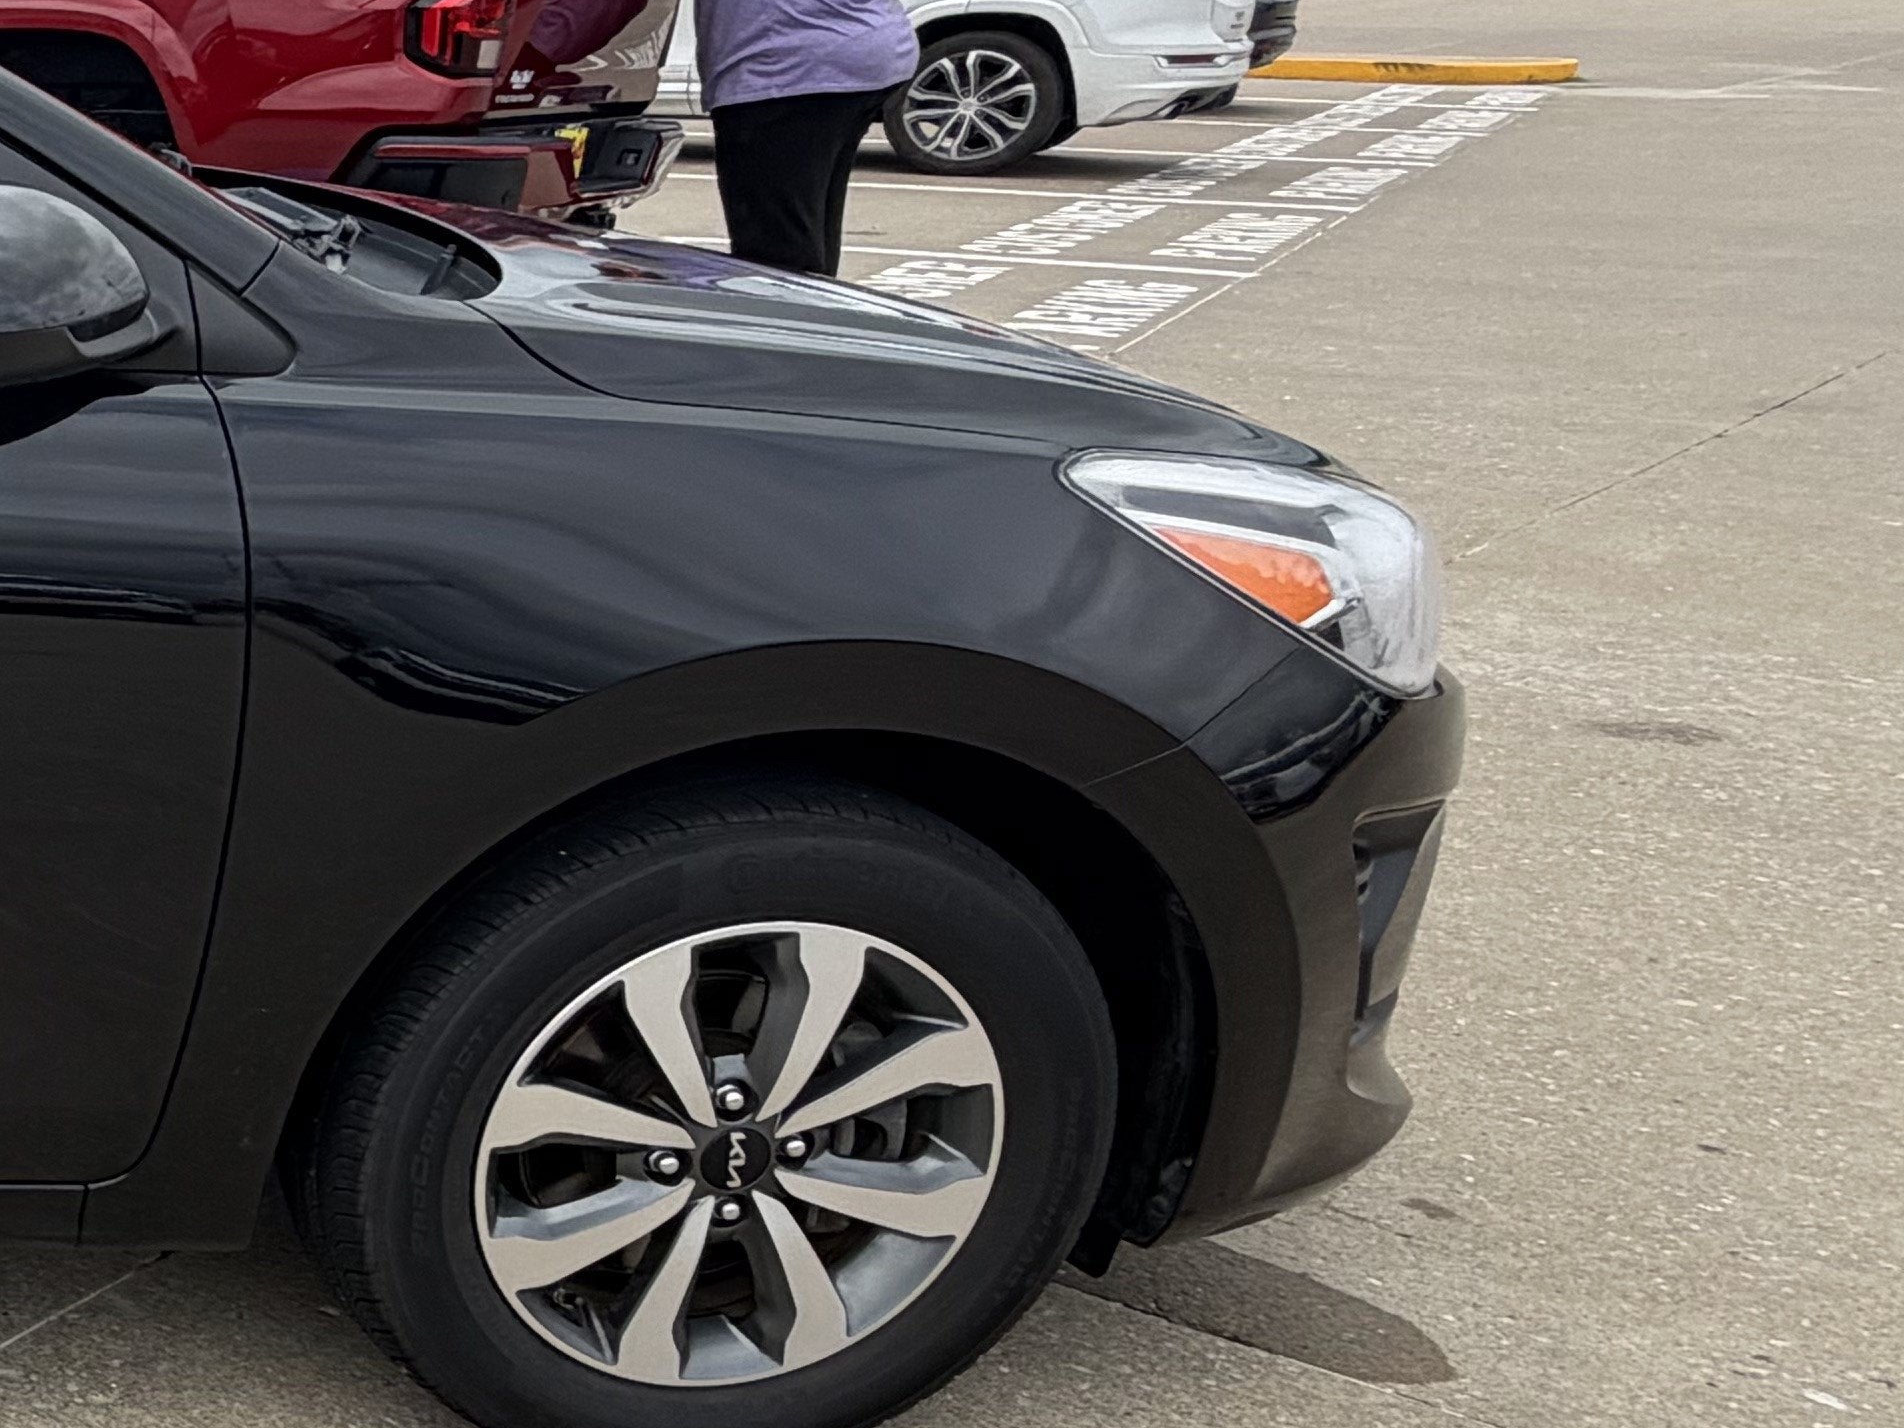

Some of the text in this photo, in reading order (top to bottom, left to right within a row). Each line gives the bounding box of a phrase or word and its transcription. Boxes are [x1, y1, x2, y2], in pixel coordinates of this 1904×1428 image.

[959, 199, 1168, 256] CUSTOMER
[1149, 212, 1324, 262] PARKING
[1000, 278, 1199, 351] ARKING
